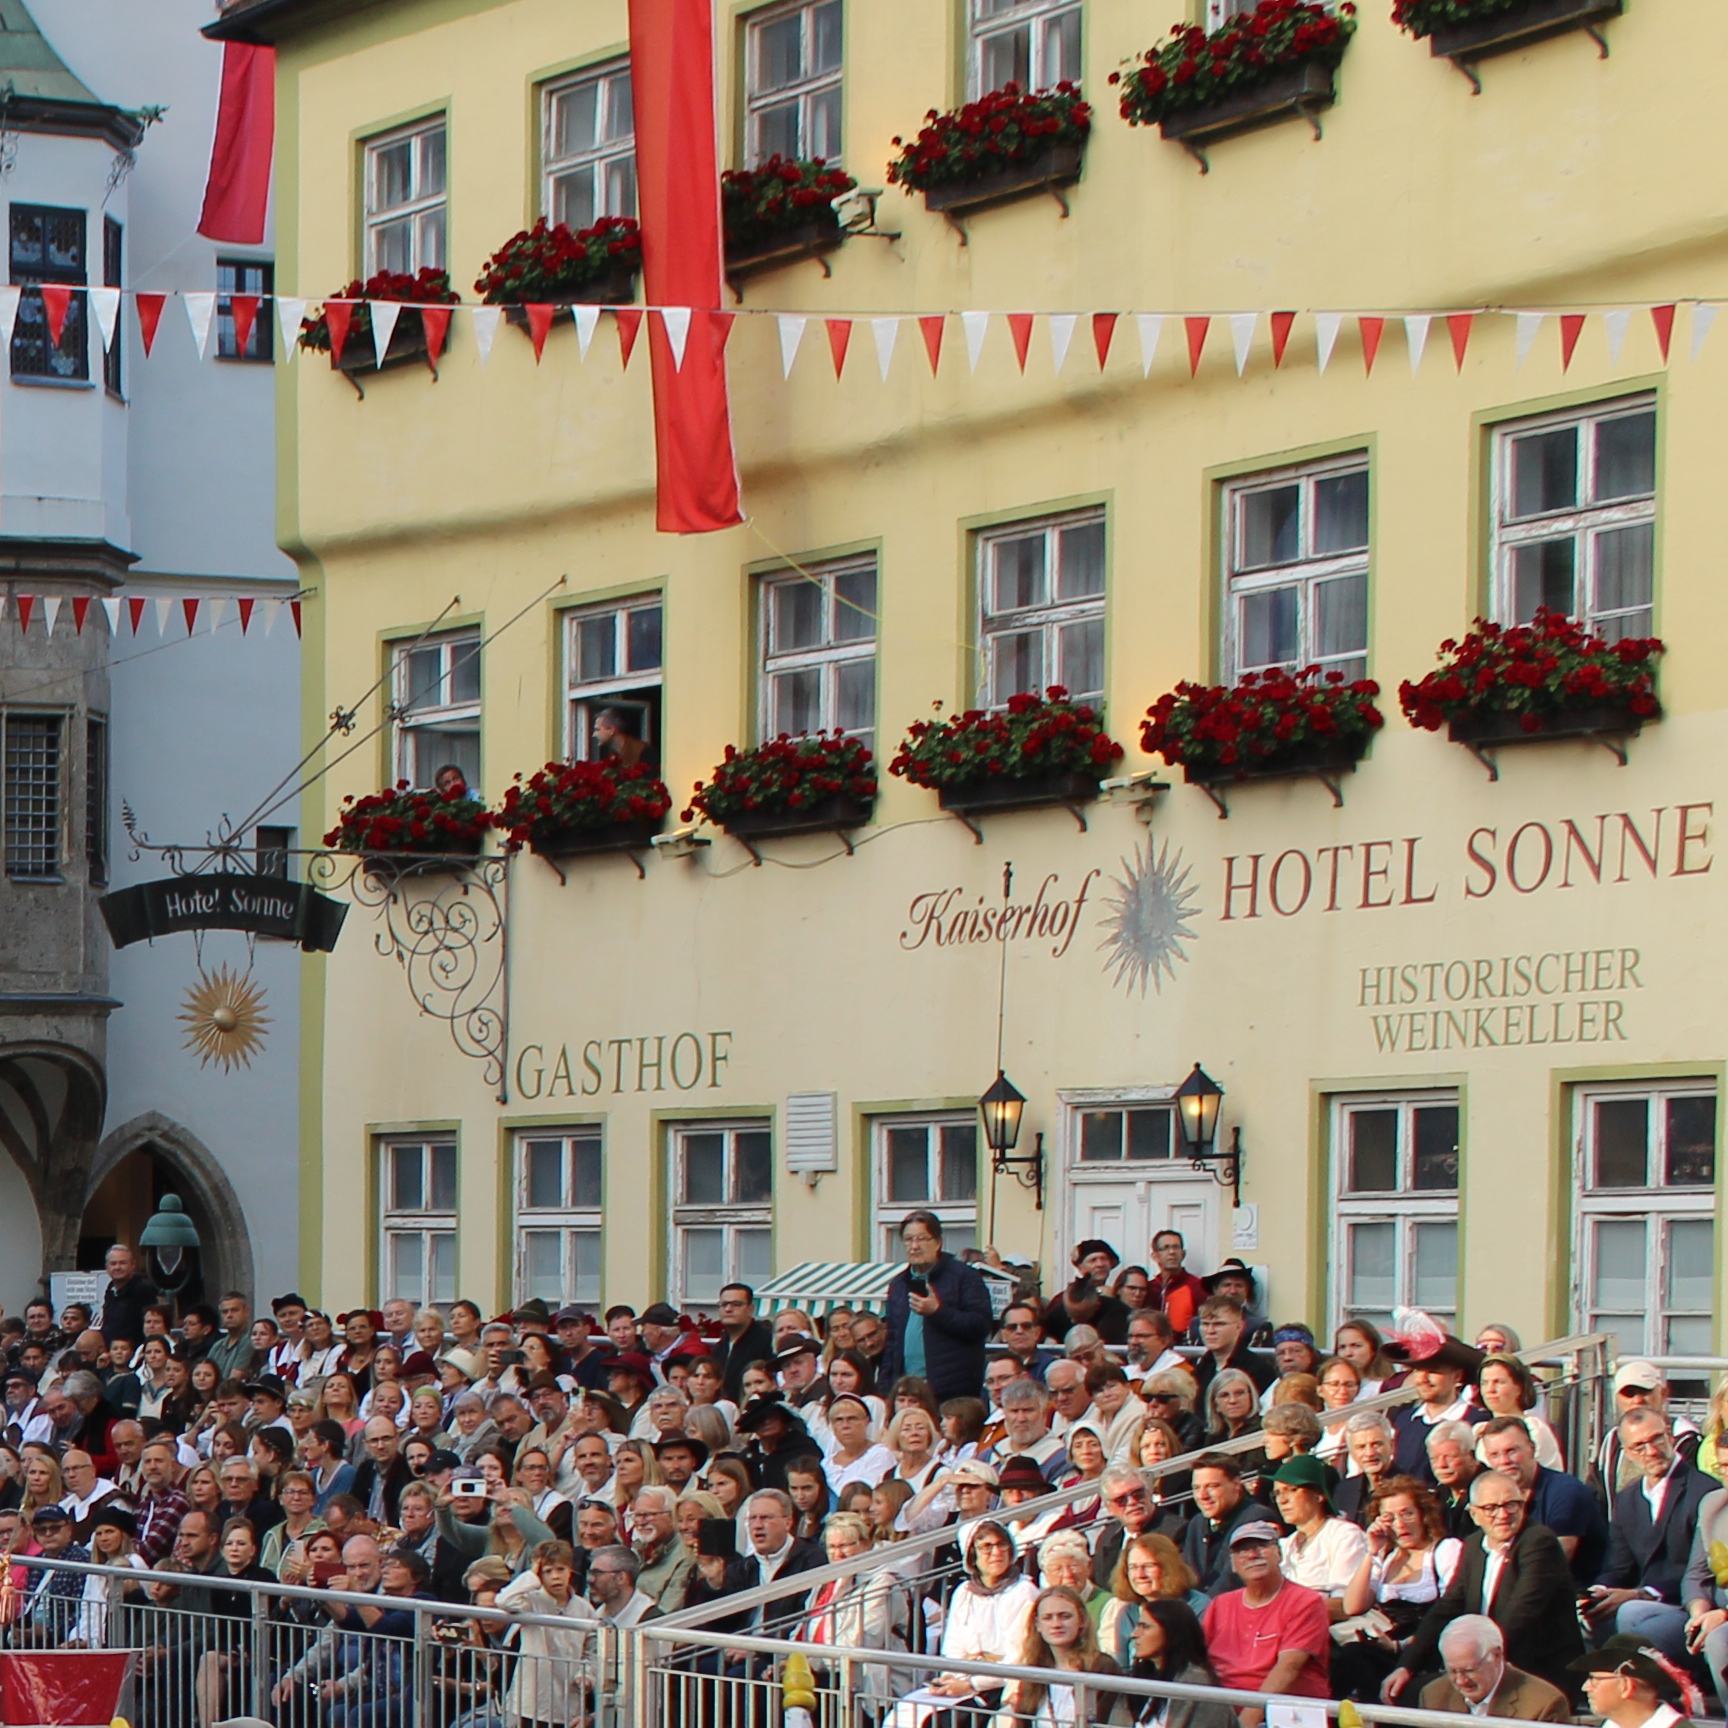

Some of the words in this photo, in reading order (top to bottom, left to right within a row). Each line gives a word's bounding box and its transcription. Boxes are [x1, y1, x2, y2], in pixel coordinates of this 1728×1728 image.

[1218, 836, 1440, 922] HOTEL
[1463, 800, 1716, 901] SONNE
[165, 887, 221, 919] Hotel
[229, 887, 294, 920] Sonne
[898, 868, 1102, 959] Kaiserhof
[1356, 946, 1645, 1007] HISTORISCHER
[1369, 999, 1629, 1055] WEINKELLER
[515, 1031, 734, 1101] GASTHOF
